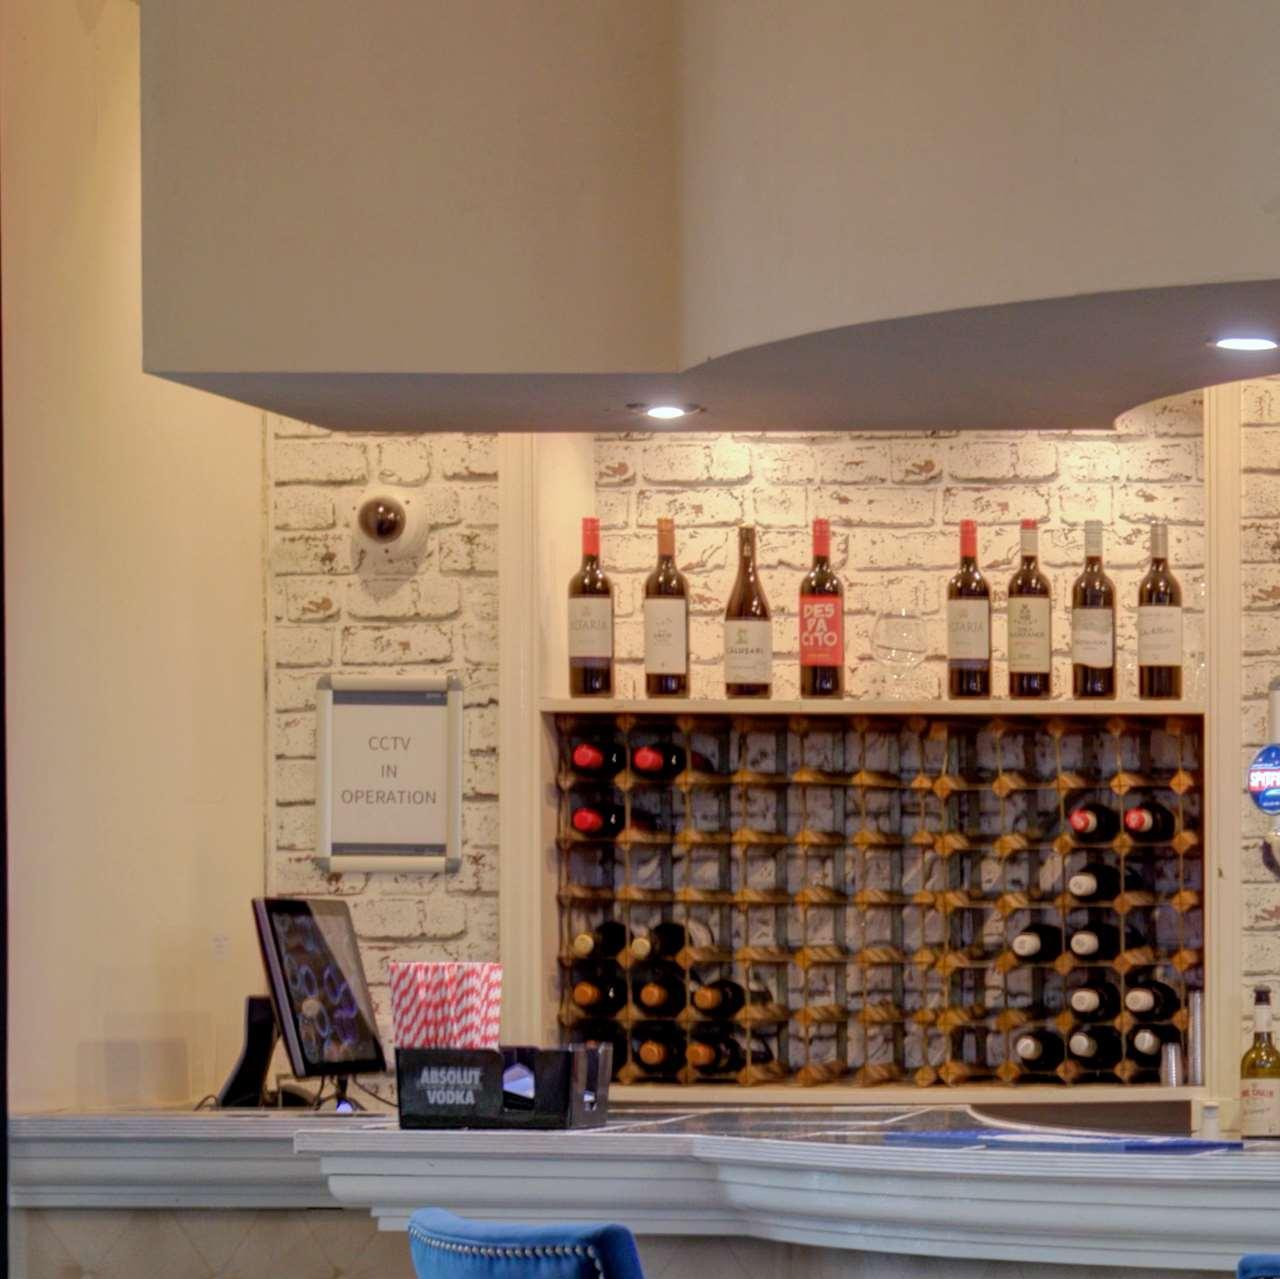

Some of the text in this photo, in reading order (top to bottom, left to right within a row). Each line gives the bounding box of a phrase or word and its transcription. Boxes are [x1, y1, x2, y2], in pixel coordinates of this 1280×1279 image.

[803, 603, 835, 618] DES
[807, 618, 828, 633] PA
[801, 632, 839, 648] CITO
[368, 736, 411, 751] CCTV
[381, 765, 397, 779] IN
[340, 790, 437, 805] OPERATION
[420, 1066, 481, 1085] ABSOLUT
[427, 1090, 475, 1104] VODKA
